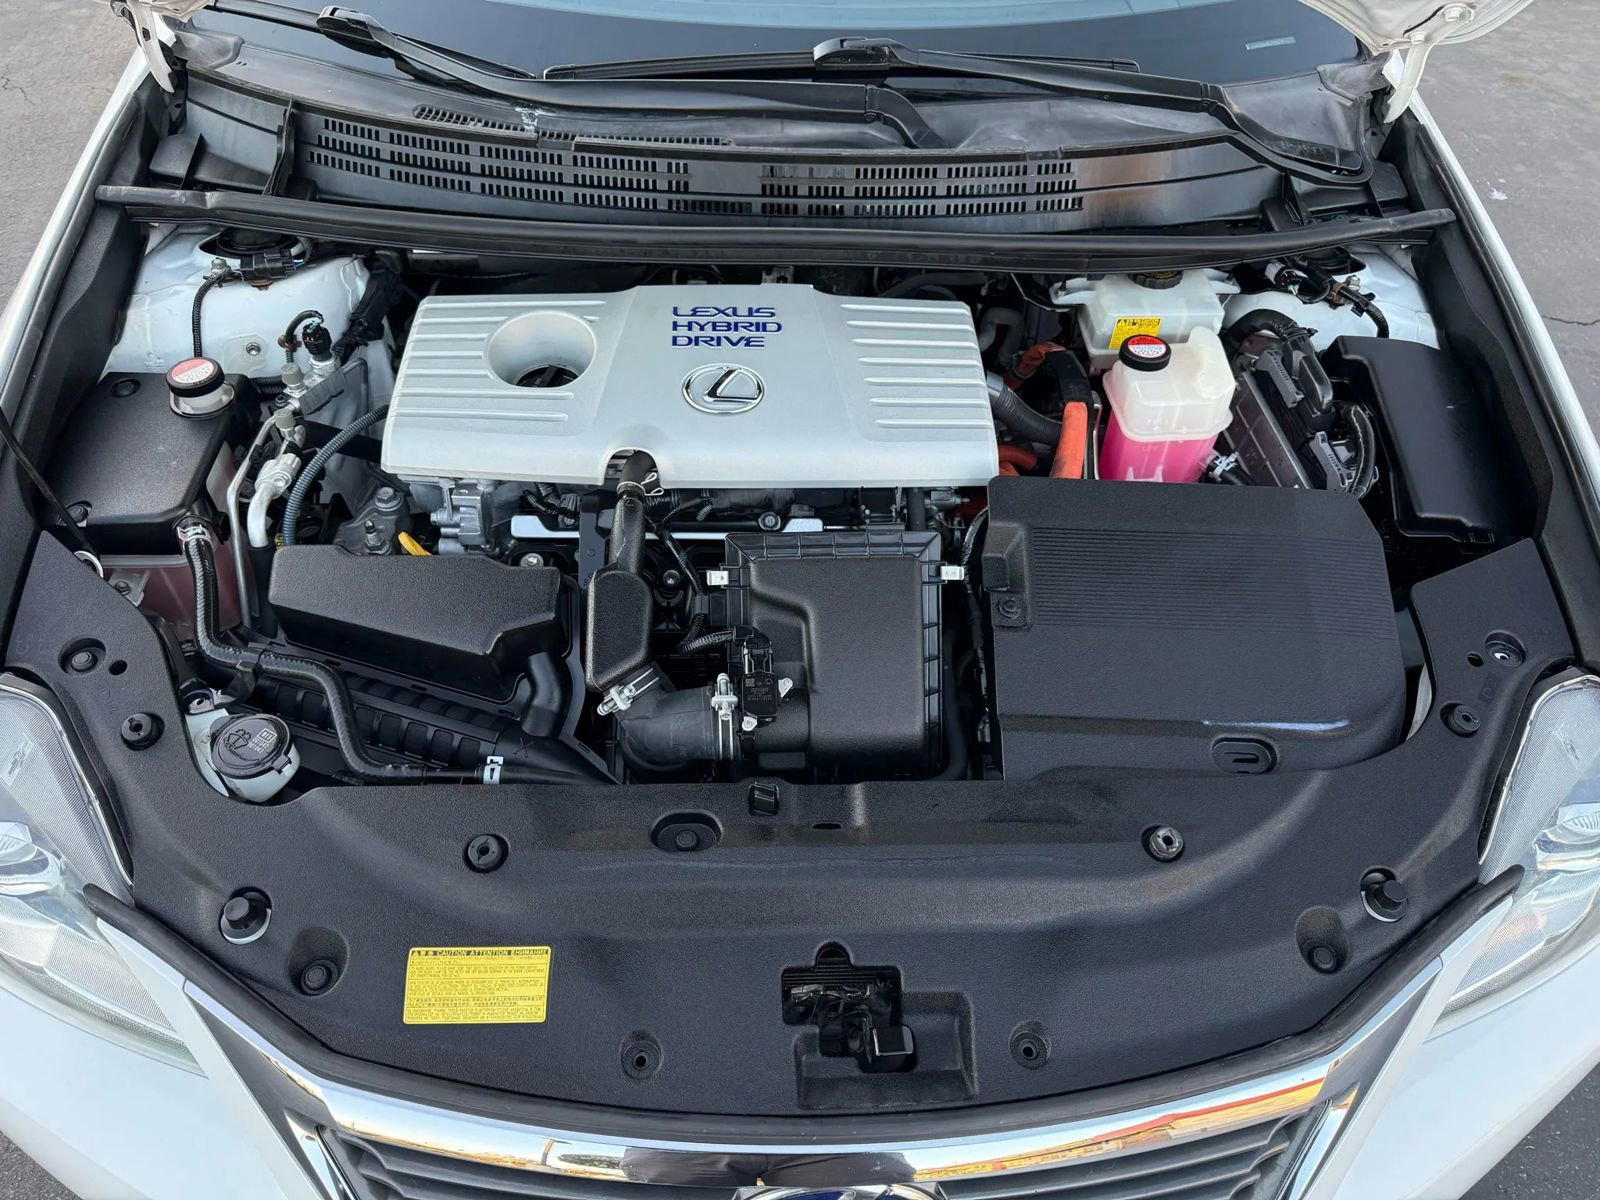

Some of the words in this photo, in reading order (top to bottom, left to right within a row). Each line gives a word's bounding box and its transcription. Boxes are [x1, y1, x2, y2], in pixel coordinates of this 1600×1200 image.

[672, 306, 776, 318] LEXUS
[672, 320, 782, 333] HYBRID
[671, 335, 765, 348] DRIVE
